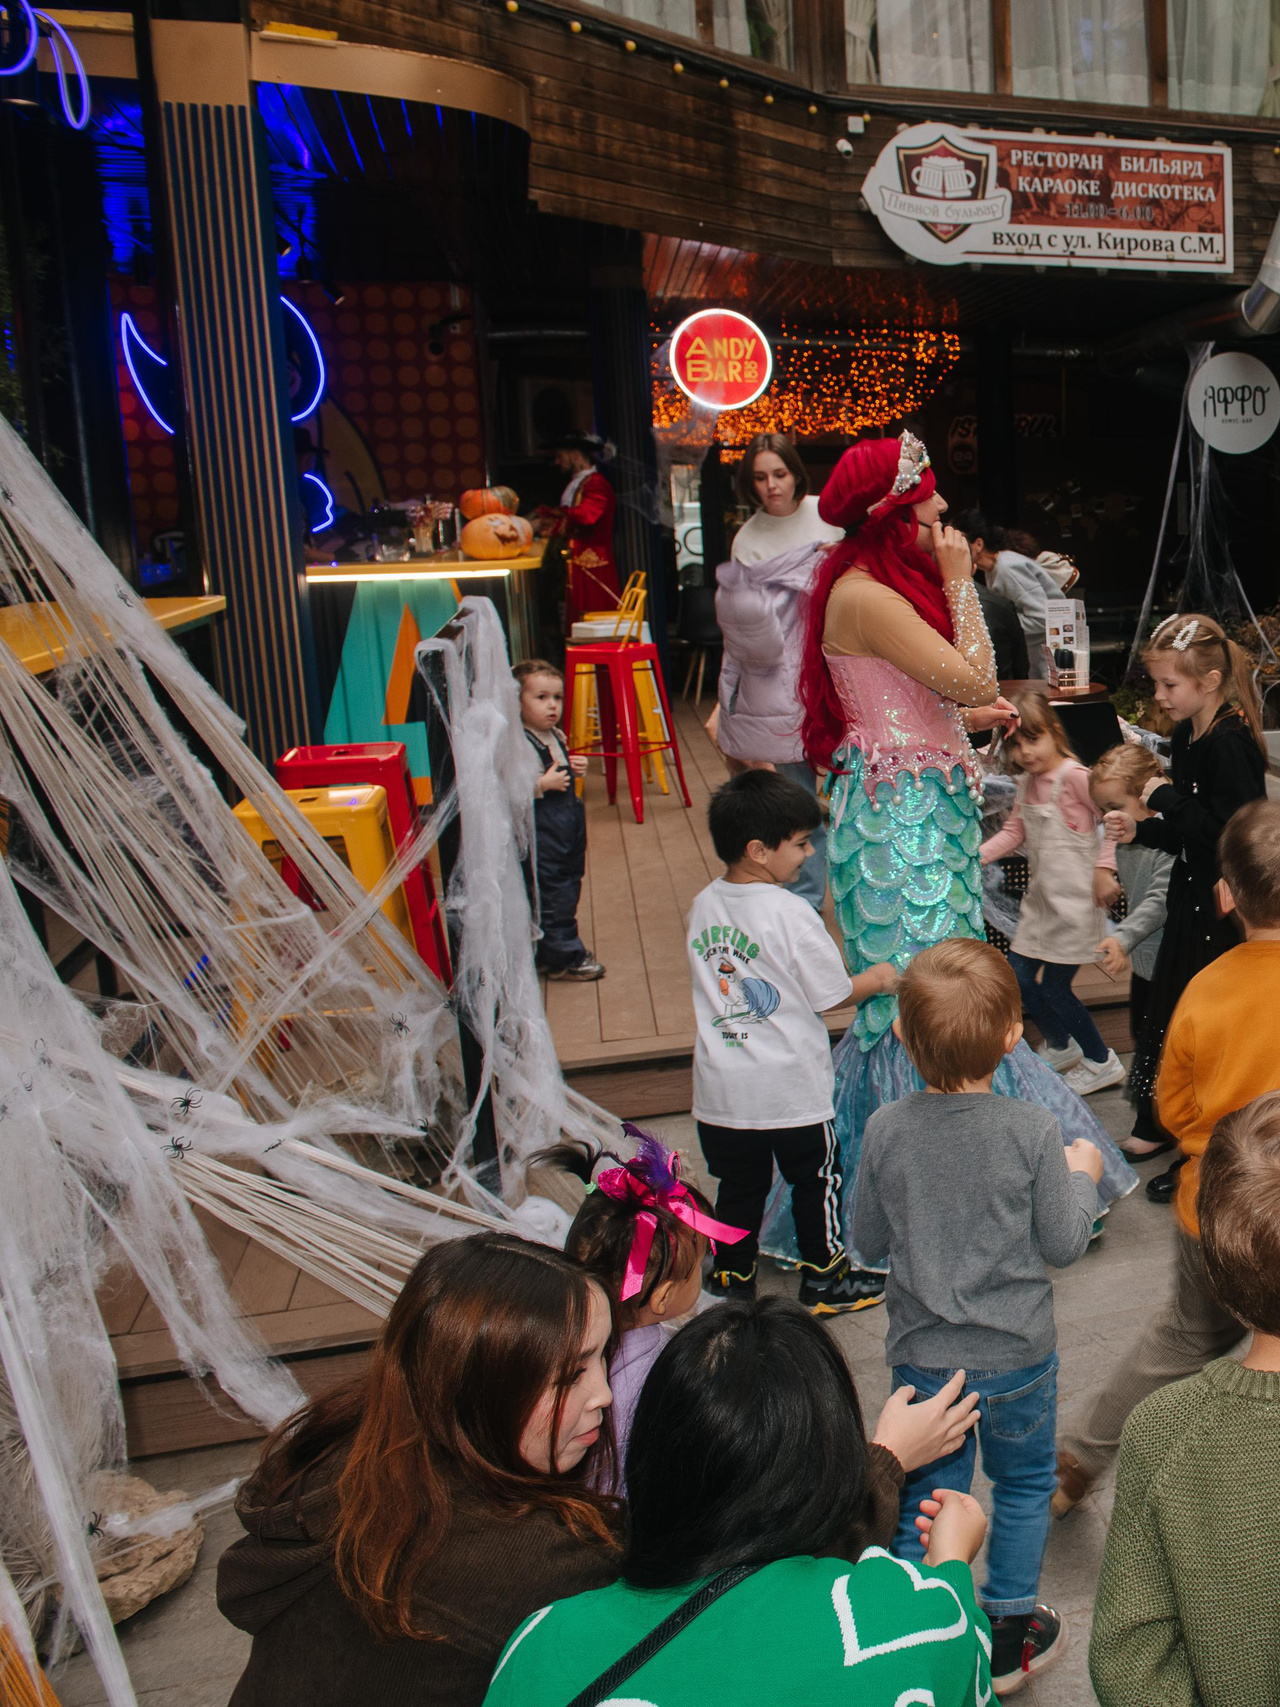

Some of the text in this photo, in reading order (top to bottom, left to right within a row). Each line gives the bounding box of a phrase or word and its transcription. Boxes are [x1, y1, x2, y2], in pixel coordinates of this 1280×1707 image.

[1010, 148, 1205, 179] РЕСТОРАН БИЛЬЯРД
[1017, 176, 1217, 203] КАРАОКЕ ДИСКОТЕКА
[993, 231, 1221, 257] вход с ул. Кирова С.М.
[684, 336, 757, 361] ANDY
[686, 359, 743, 384] BAR
[741, 1032, 749, 1040] IS
